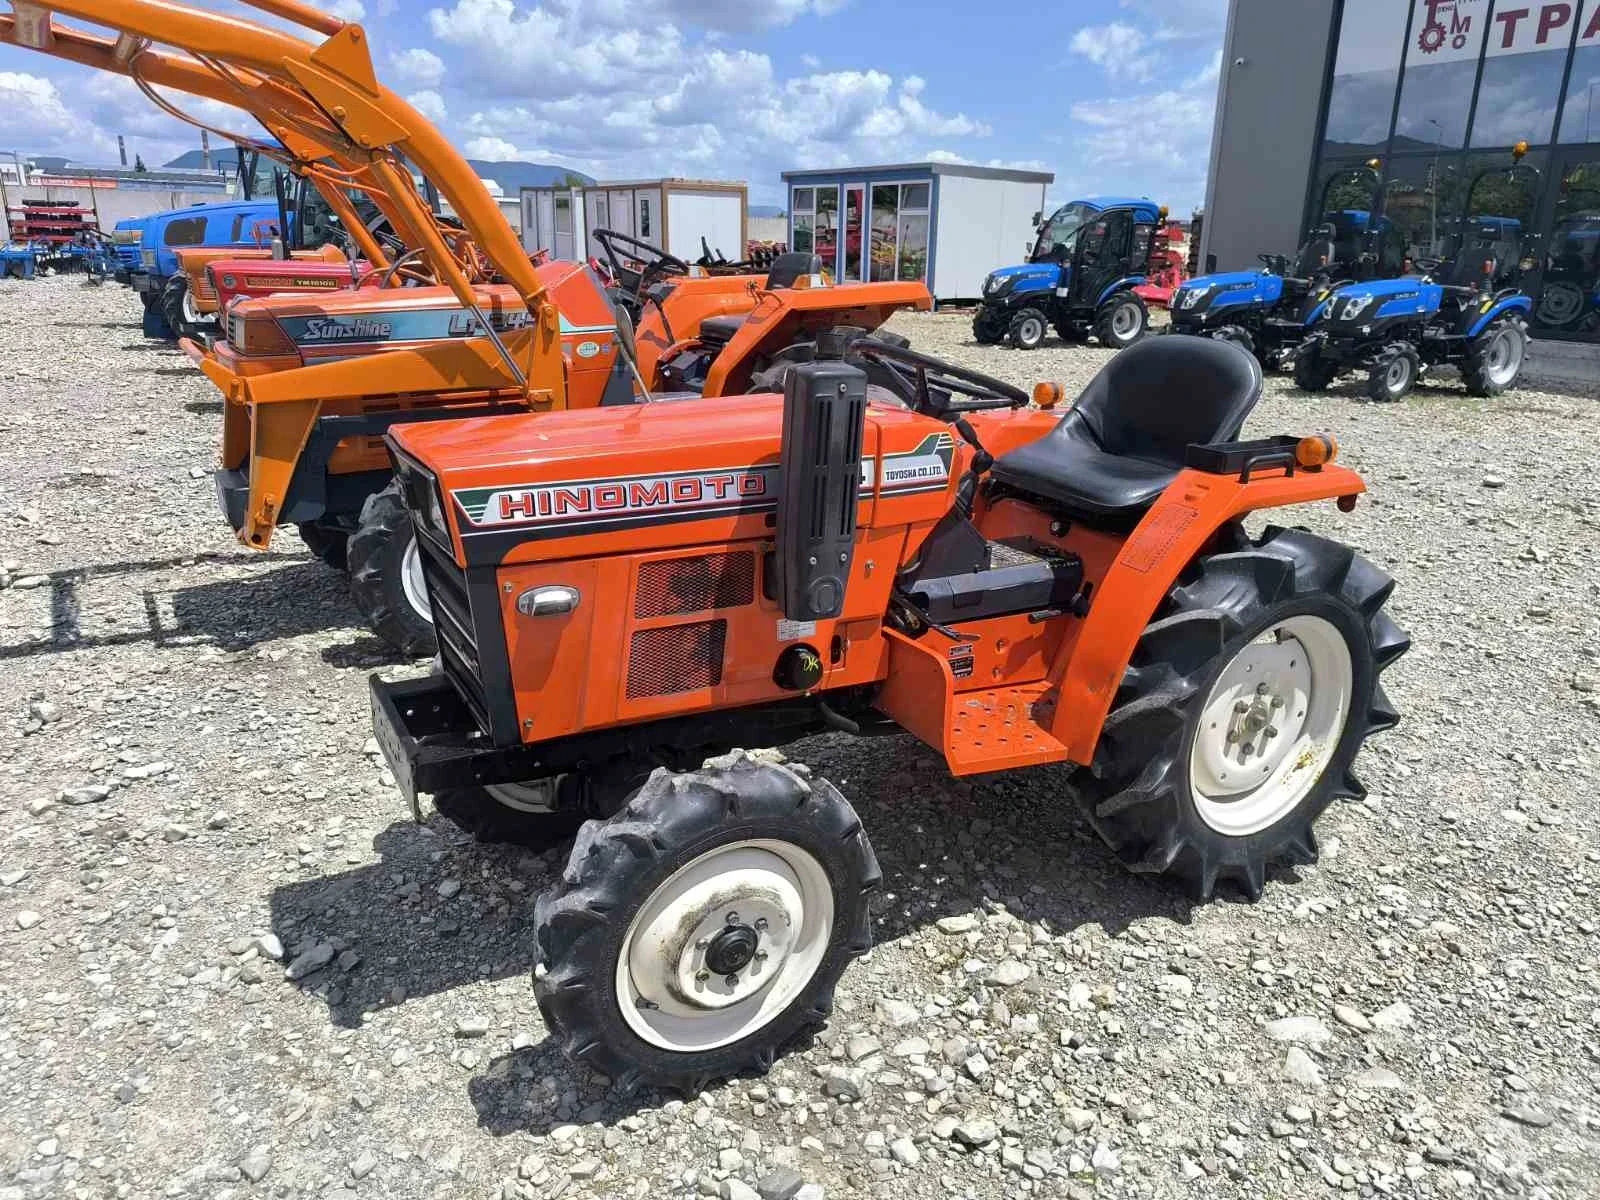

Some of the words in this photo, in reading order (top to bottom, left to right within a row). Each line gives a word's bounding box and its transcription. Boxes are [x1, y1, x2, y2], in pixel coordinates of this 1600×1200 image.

[303, 318, 393, 341] Sunshine
[886, 469, 917, 481] TOYOSHA
[499, 473, 767, 519] HINOMOTO
